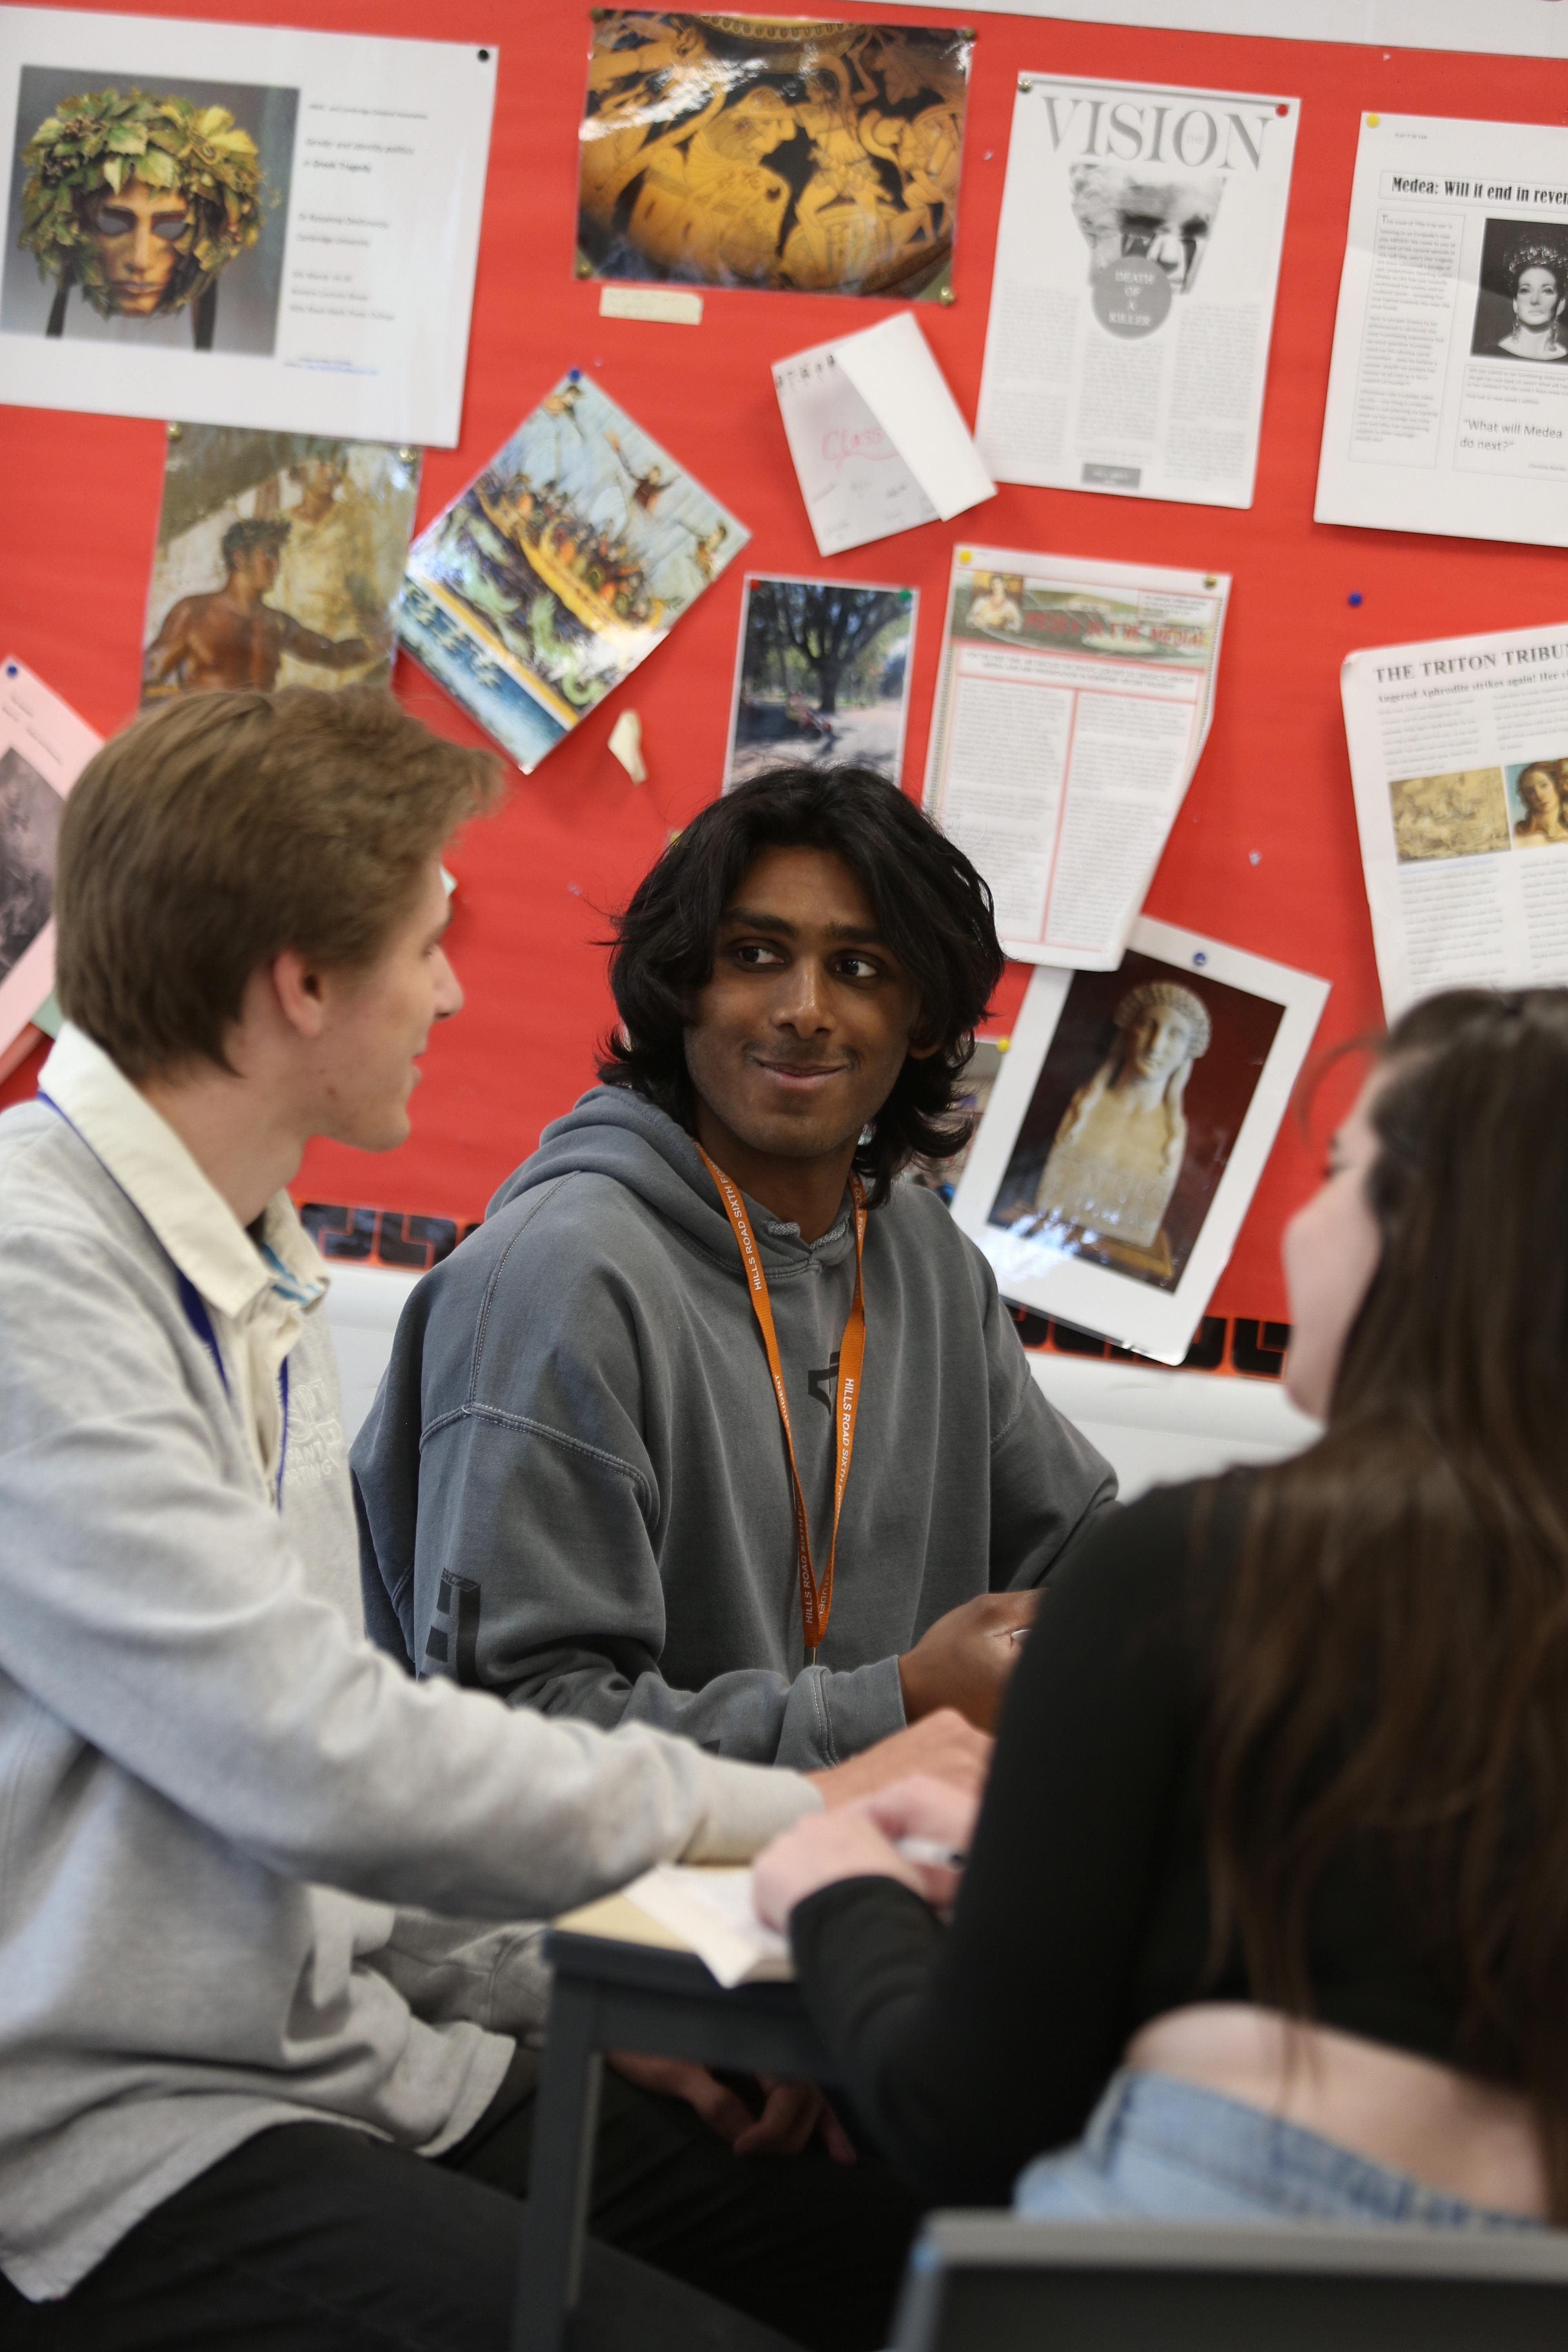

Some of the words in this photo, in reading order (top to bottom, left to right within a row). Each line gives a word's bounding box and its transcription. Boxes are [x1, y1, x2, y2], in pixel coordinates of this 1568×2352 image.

[1042, 96, 1274, 172] VISION
[1392, 177, 1439, 195] Medea:
[1444, 180, 1470, 197] Will
[1473, 183, 1483, 199] it
[1487, 186, 1512, 201] end
[1516, 187, 1529, 203] in
[1109, 311, 1152, 327] KILLER
[1460, 437, 1474, 449] do
[1501, 422, 1519, 435] will
[1523, 425, 1562, 439] Medea
[1374, 665, 1414, 683] THE
[1420, 654, 1496, 677] TRITON
[1423, 684, 1469, 699] Aphrodite
[1472, 680, 1503, 690] strikes
[1539, 672, 1558, 682] Her
[724, 1186, 742, 1218] SIXTH
[737, 1221, 753, 1254] ROAD
[748, 1256, 762, 1291] HILLS
[843, 1378, 854, 1411] HILLS
[842, 1413, 851, 1446] ROAD
[839, 1449, 848, 1483] SIXTH
[801, 1556, 811, 1588] ROAD
[804, 1591, 813, 1624] HILLS
